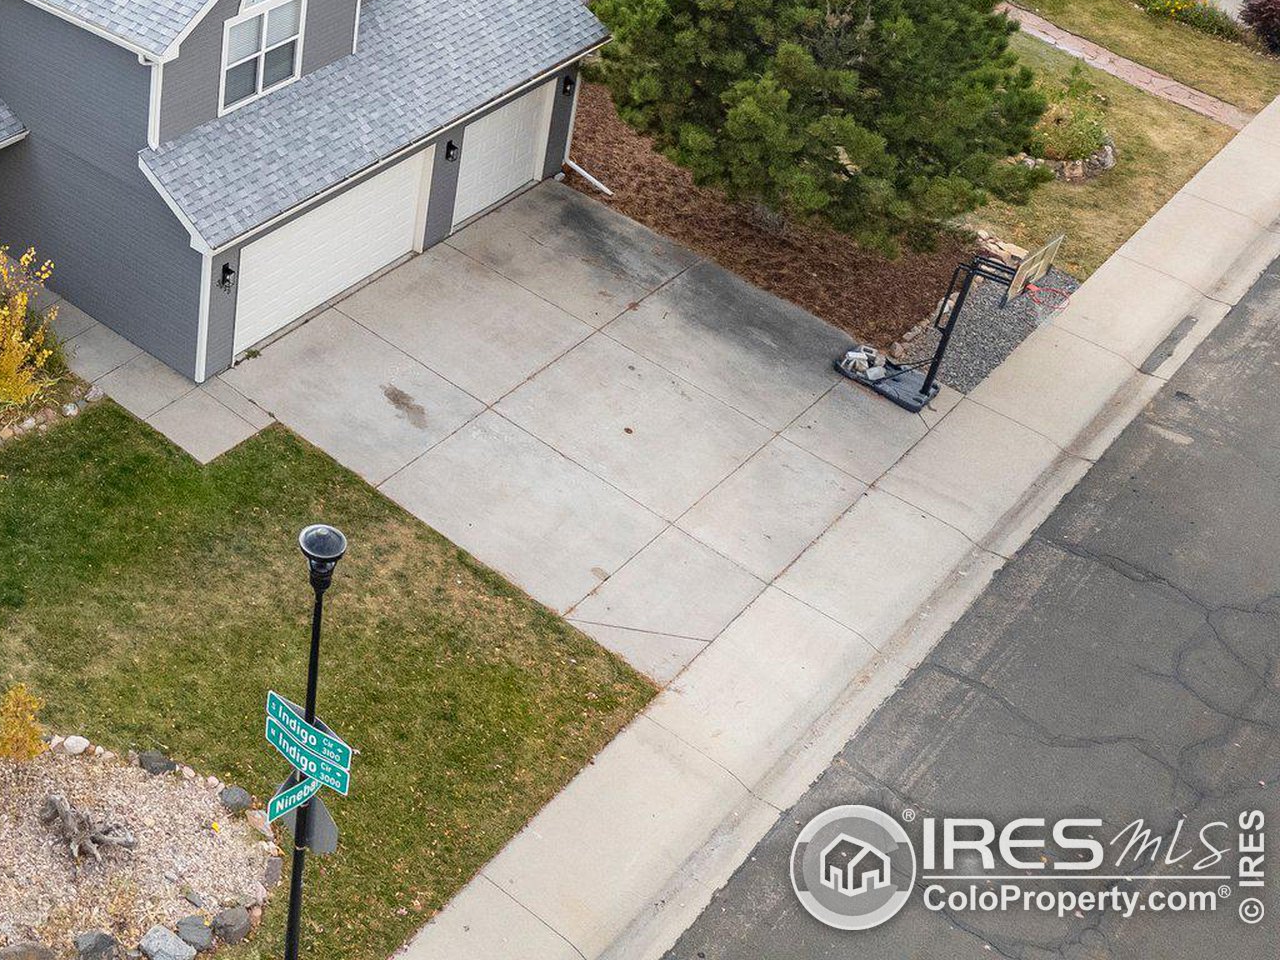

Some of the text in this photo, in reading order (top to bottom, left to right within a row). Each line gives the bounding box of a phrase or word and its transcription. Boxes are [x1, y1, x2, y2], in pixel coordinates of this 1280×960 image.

[278, 705, 317, 746] Indigo
[322, 738, 334, 748] Cir
[278, 732, 317, 773] Indigo
[320, 762, 332, 773] Cir
[321, 747, 341, 762] 3100
[319, 772, 341, 788] 3000
